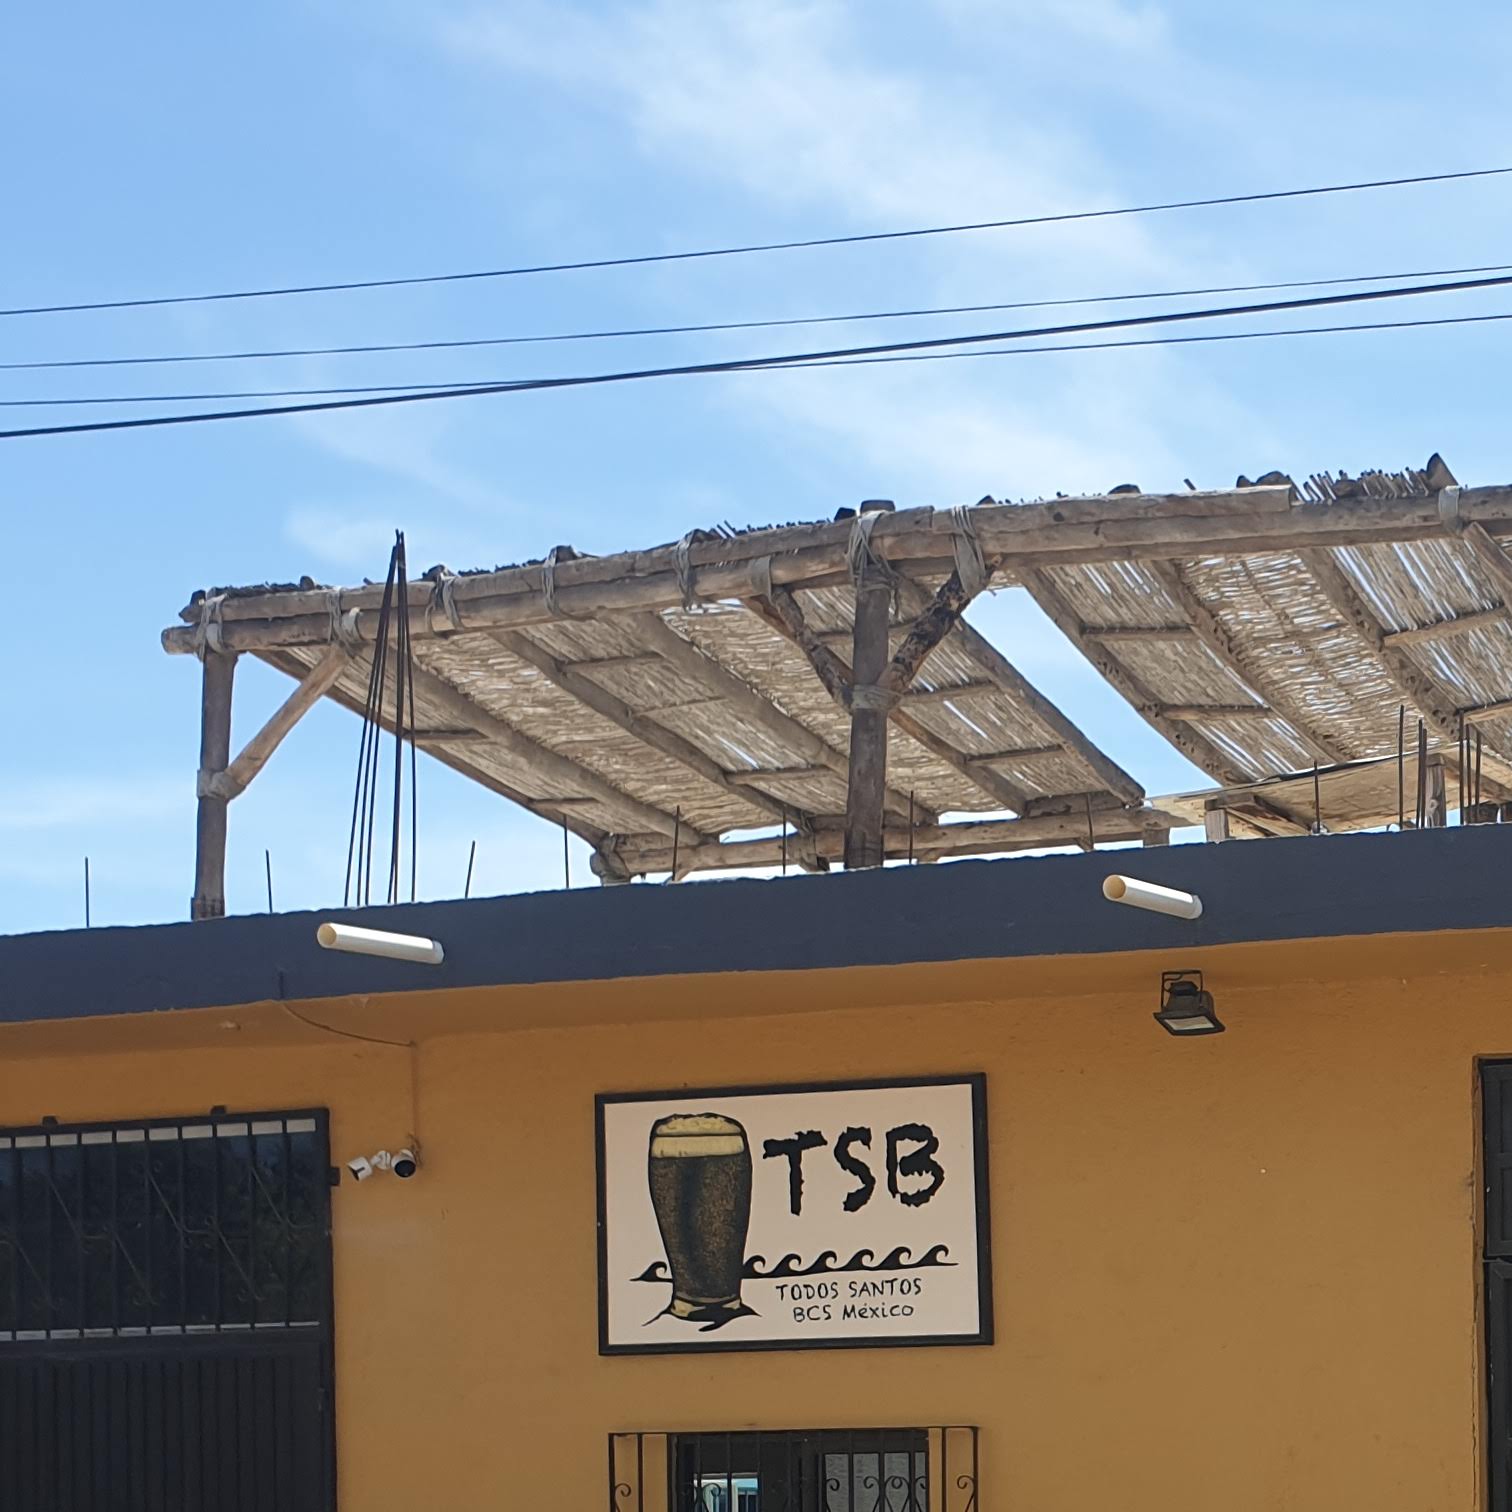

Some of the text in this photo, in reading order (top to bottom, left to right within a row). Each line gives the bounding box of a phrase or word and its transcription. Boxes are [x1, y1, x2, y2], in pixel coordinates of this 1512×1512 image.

[763, 1123, 945, 1216] TSB
[775, 1278, 922, 1300] TODOS SANTOS
[793, 1302, 914, 1322] BCS México
